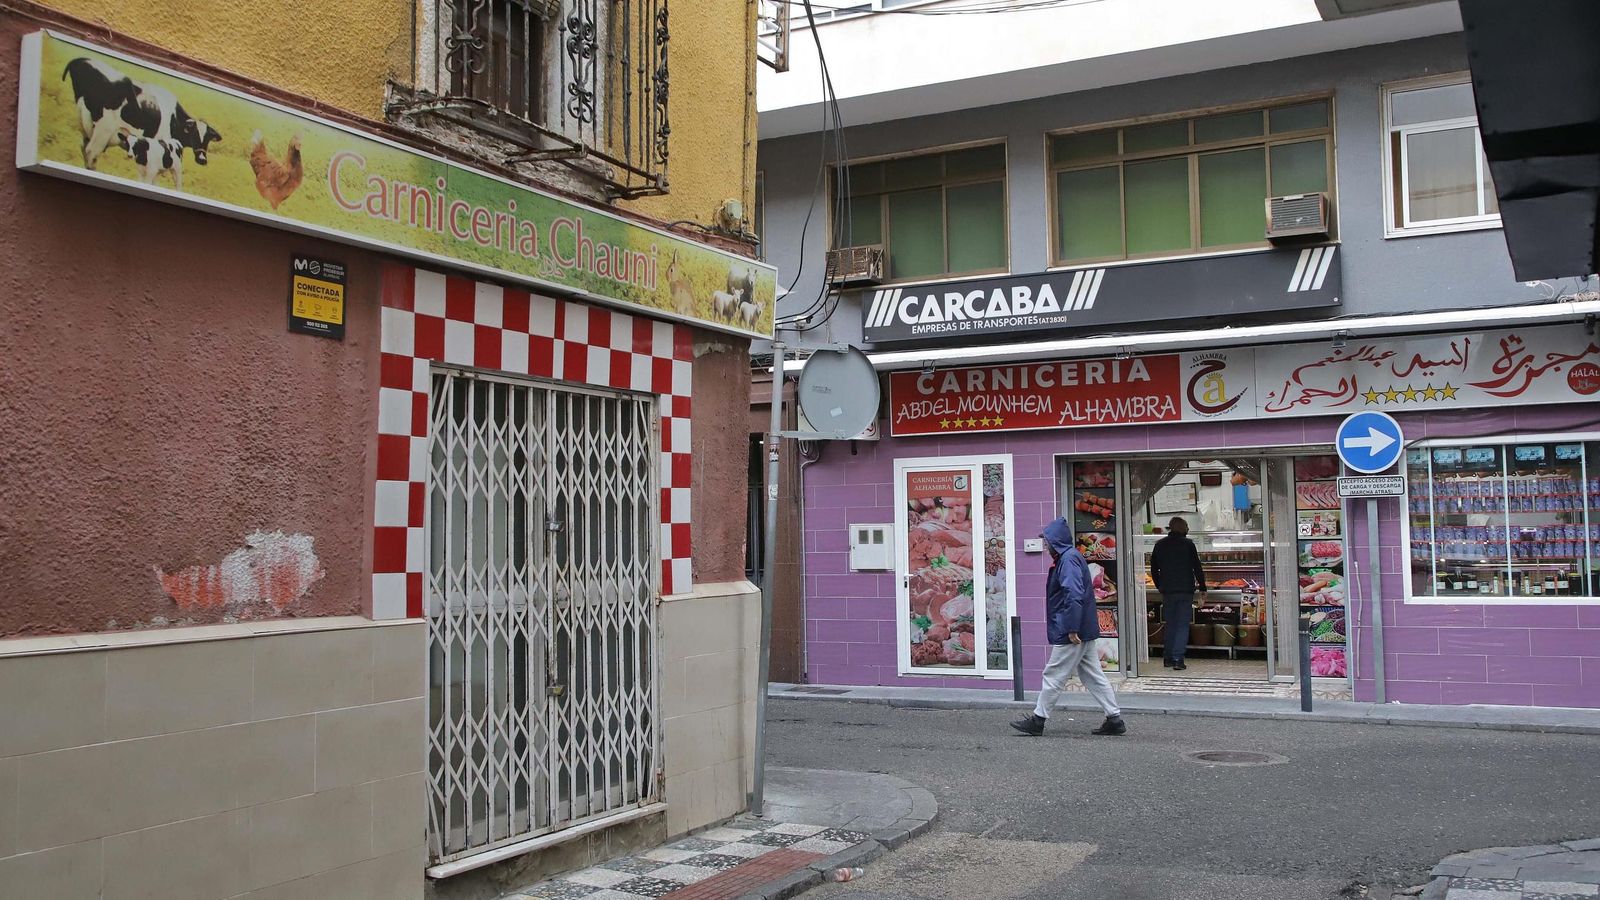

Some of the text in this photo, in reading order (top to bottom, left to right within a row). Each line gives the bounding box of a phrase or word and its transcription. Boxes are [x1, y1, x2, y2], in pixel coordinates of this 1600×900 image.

[328, 152, 657, 291] Carniceria Chauni
[297, 282, 340, 297] CONECTADA
[898, 283, 1060, 325] CARCABA
[912, 323, 957, 334] EMPRESAS
[960, 321, 971, 331] DE
[973, 316, 1038, 330] TRANSPORTES
[1192, 353, 1227, 363] ALHAMBRA
[1571, 368, 1600, 378] HALAL
[896, 398, 956, 425] ABDEL
[957, 394, 1053, 416] MOUNHEM
[1058, 395, 1176, 425] ALHAMBRA
